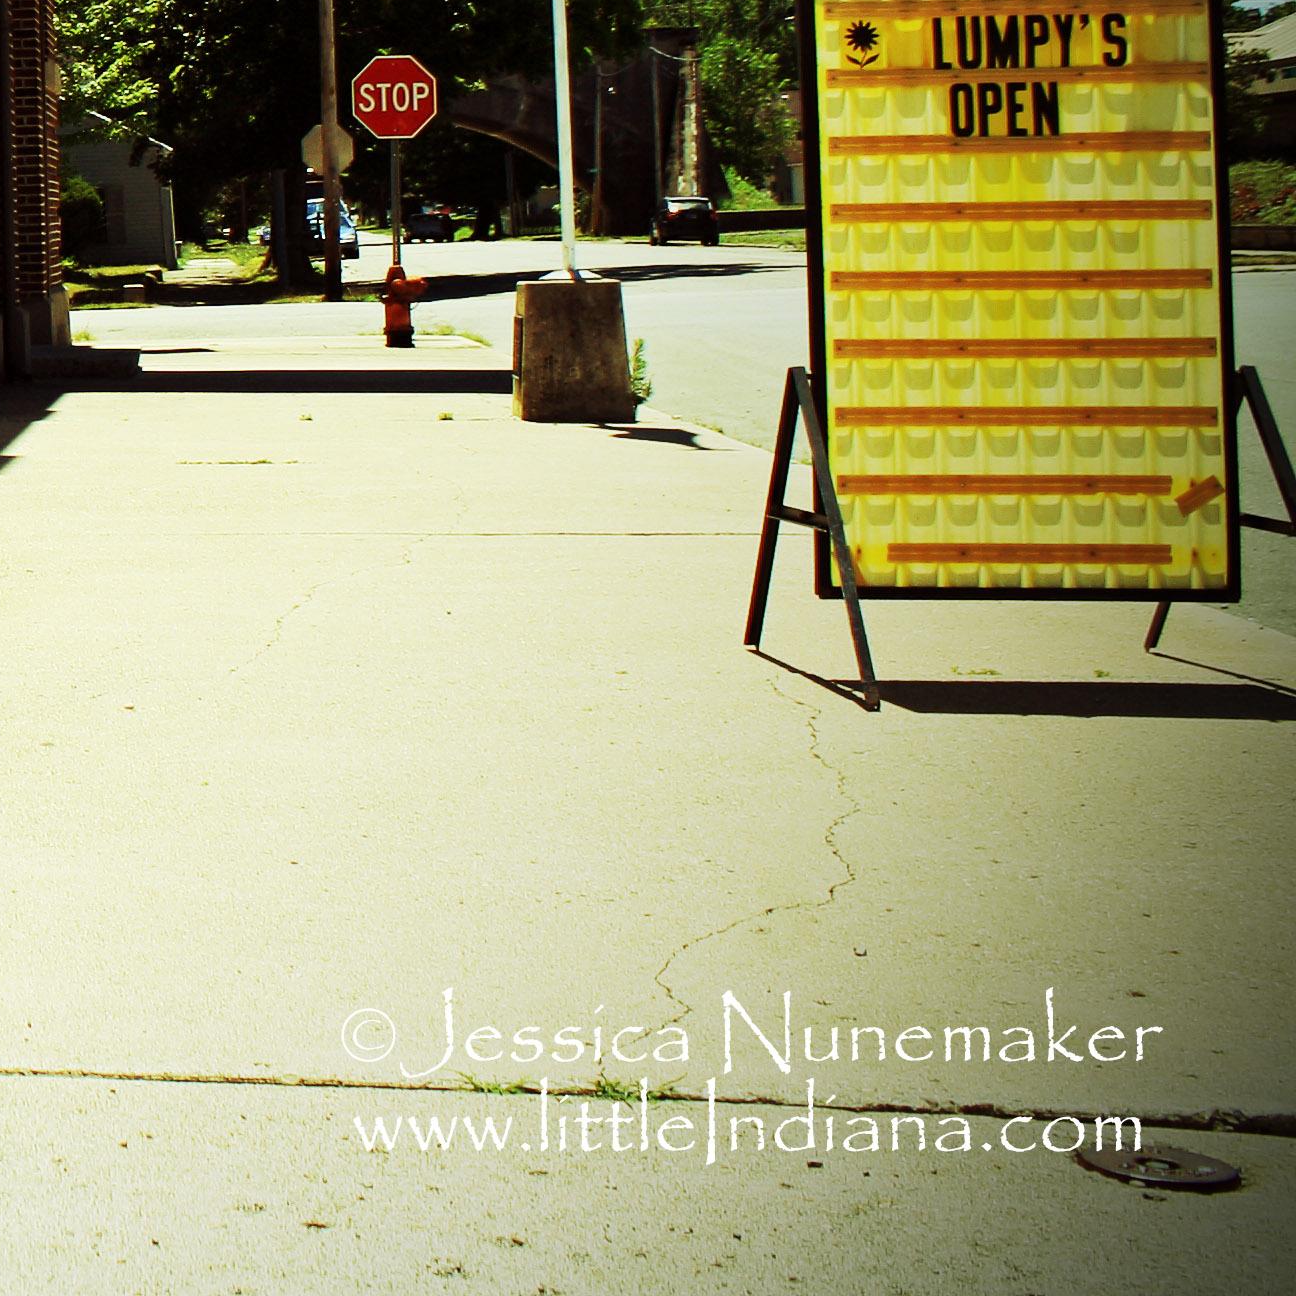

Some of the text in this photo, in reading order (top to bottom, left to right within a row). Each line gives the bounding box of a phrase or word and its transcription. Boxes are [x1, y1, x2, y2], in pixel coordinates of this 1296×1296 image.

[933, 13, 1127, 70] LUMPY'S
[358, 82, 430, 113] STOP
[950, 81, 1060, 138] OPEN
